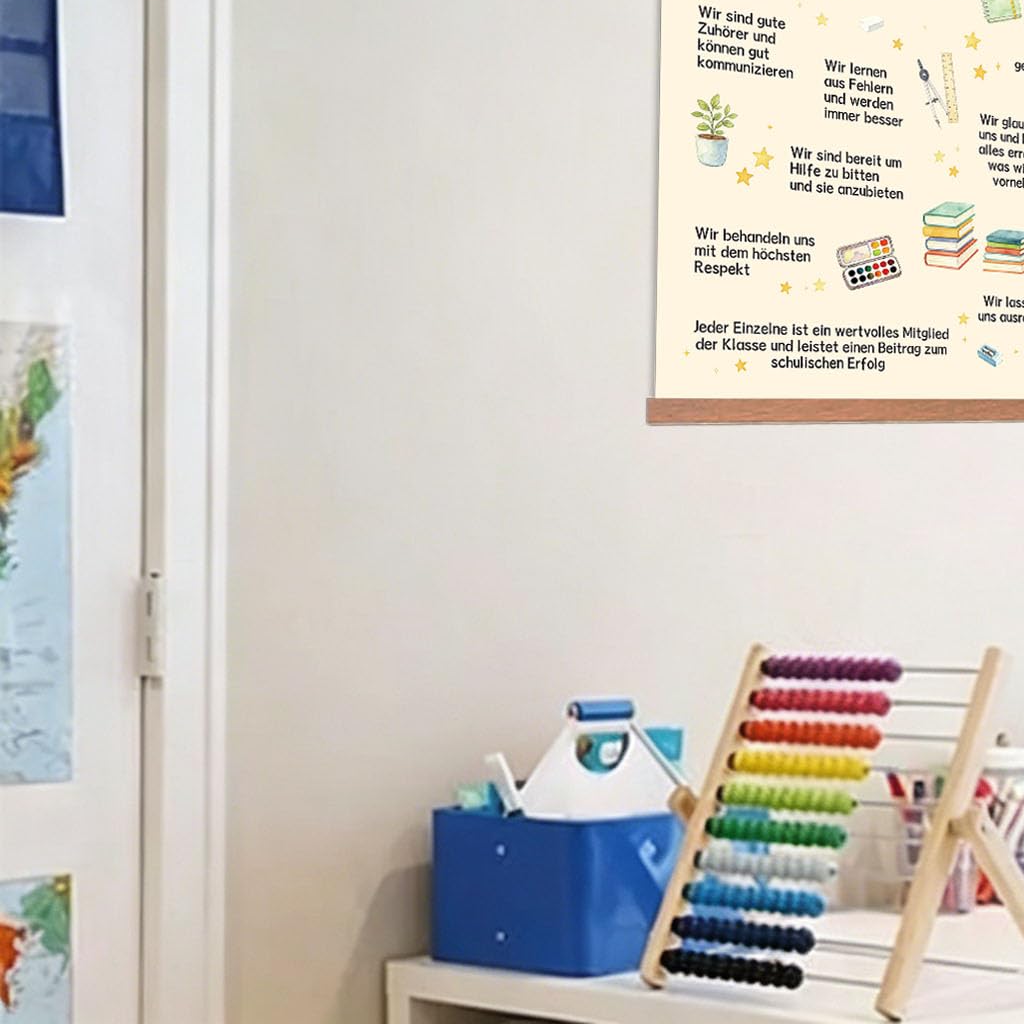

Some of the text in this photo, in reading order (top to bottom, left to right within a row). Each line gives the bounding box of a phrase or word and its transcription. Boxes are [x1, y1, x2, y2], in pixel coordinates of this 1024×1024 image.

[698, 5, 786, 30] Wir sind gute
[698, 21, 776, 44] Zuhörer und
[698, 38, 769, 60] können gut
[697, 55, 793, 79] kommunizieren
[825, 59, 887, 79] Wir lernen
[824, 78, 893, 95] aus Fehlern
[824, 92, 893, 110] und werden
[824, 107, 903, 127] immer besser
[980, 113, 999, 126] Wir
[979, 131, 997, 141] uns
[1000, 133, 1019, 144] und
[790, 146, 902, 168] Wir sind bereit um
[979, 144, 1005, 157] alles
[790, 162, 879, 182] Hilfe zu bitten
[988, 162, 1010, 172] was
[790, 180, 903, 200] und sie anzubieten
[695, 226, 815, 247] Wir behandeln uns
[695, 245, 811, 262] mit dem höchsten
[694, 260, 750, 277] Respekt
[983, 295, 1002, 307] Wir
[978, 313, 996, 322] uns
[694, 320, 949, 341] Jeder Einzelne ist ein wertvolles Mitglied
[695, 337, 947, 357] der Klasse und leistet einen Beitrag zum
[771, 356, 885, 372] schulischen Erfolg
